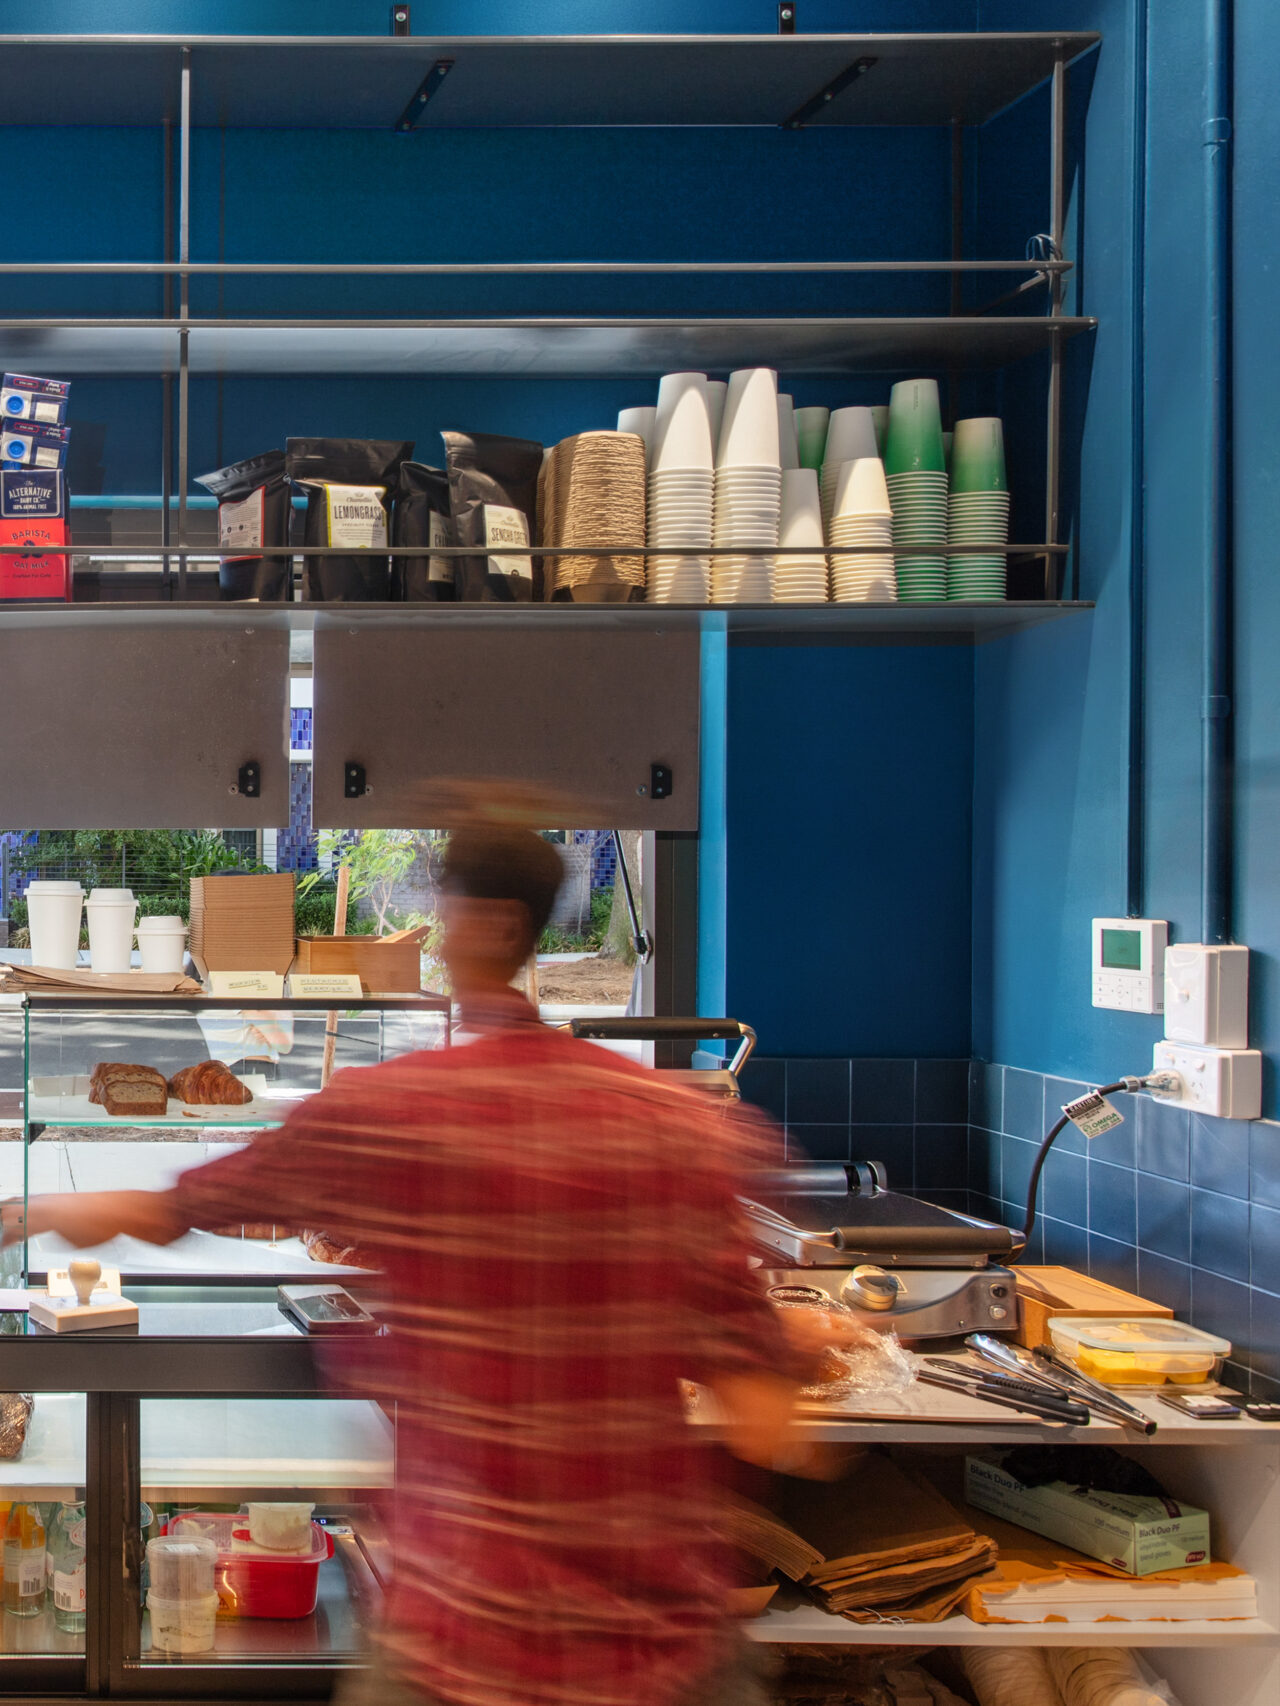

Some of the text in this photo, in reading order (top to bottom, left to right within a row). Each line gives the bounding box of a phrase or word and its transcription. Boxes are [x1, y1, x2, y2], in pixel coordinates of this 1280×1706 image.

[8, 487, 52, 499] ALTERNATIVE
[12, 530, 50, 540] BARISTA
[14, 560, 49, 569] OAT MILK
[1070, 1096, 1097, 1112] CAUTION
[1091, 1112, 1118, 1128] OMEGA
[970, 1463, 1026, 1493] Black Duo PF
[1139, 1523, 1181, 1538] Black Duo PF
